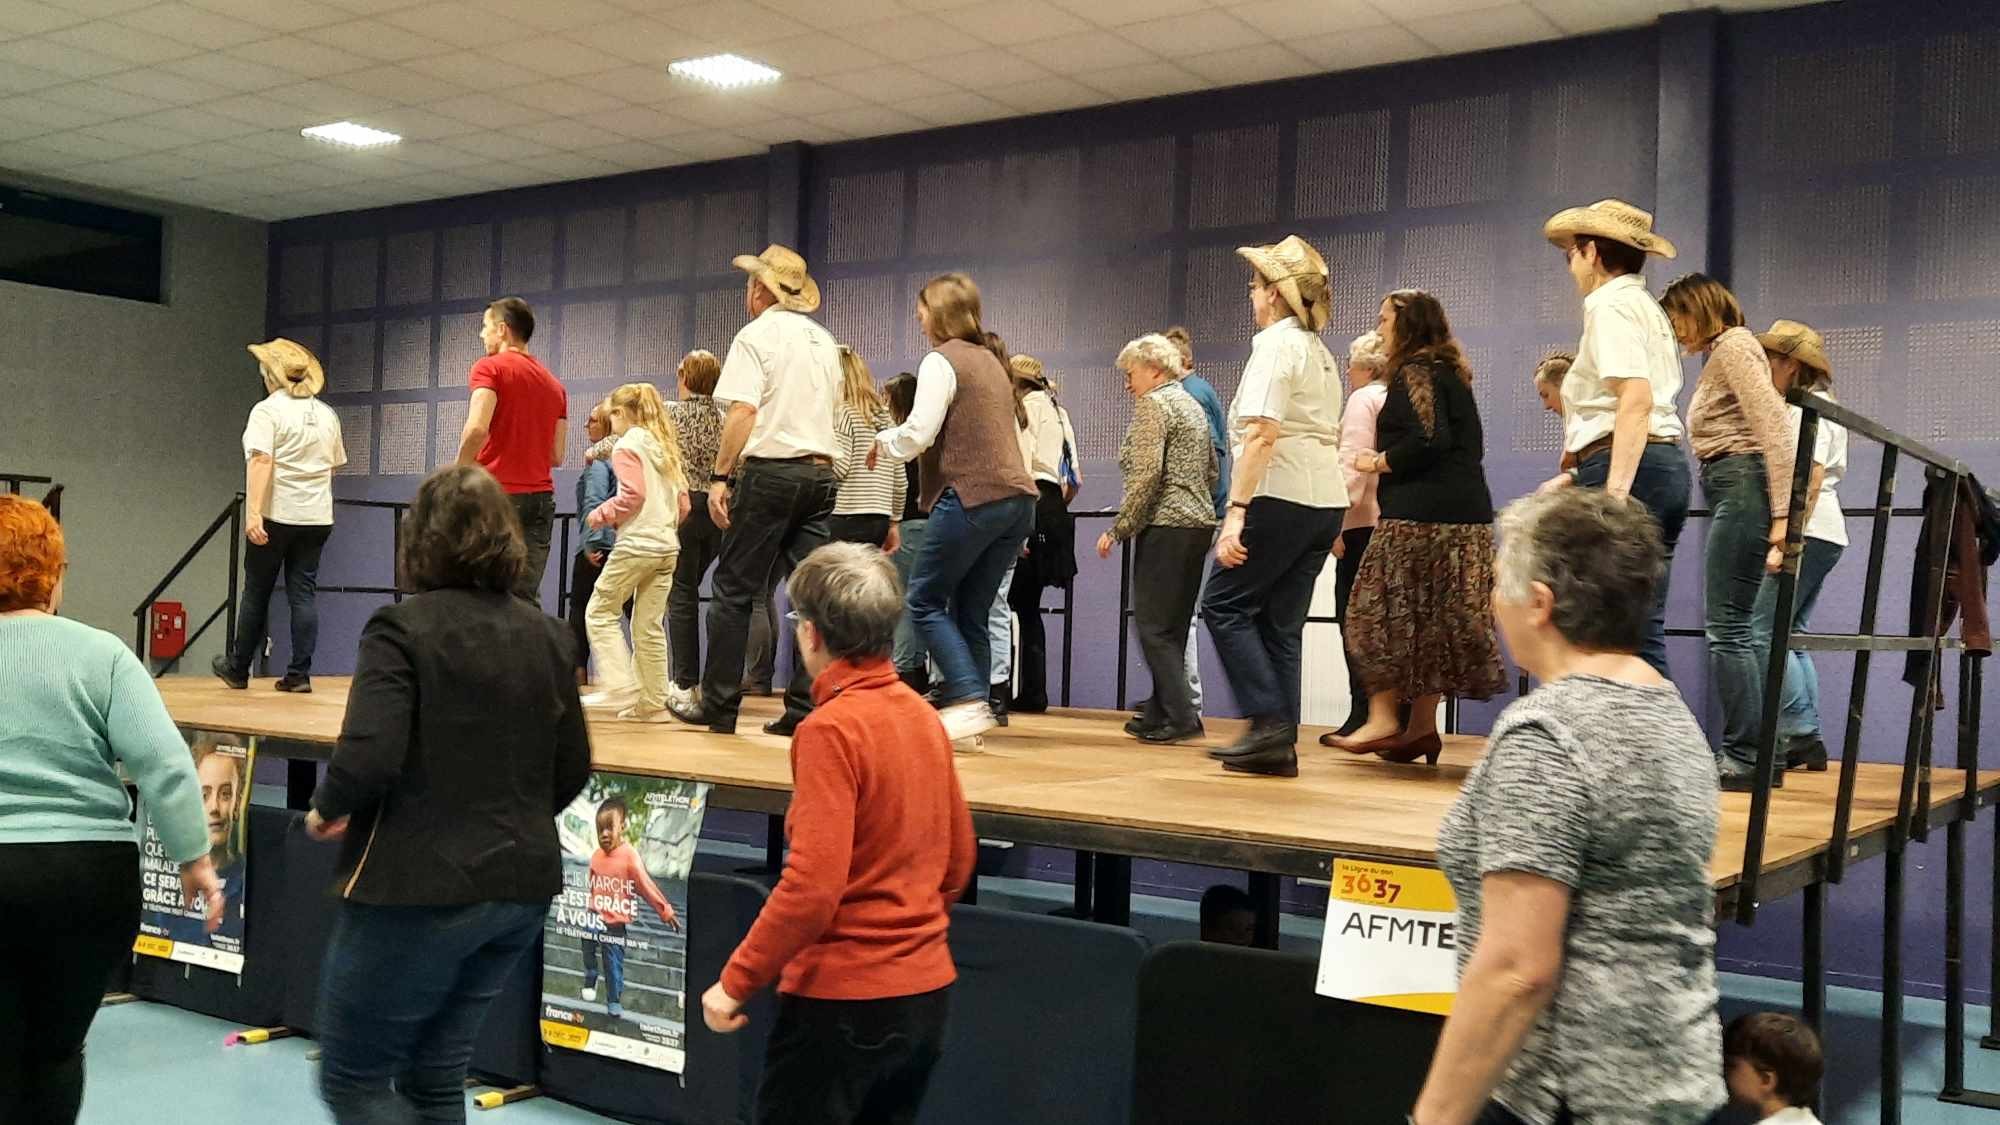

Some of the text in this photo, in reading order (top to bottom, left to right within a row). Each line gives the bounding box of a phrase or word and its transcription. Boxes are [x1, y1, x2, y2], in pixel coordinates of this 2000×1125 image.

[143, 871, 157, 887] CE
[1341, 873, 1402, 904] 3637
[593, 892, 638, 917] GRÂCE
